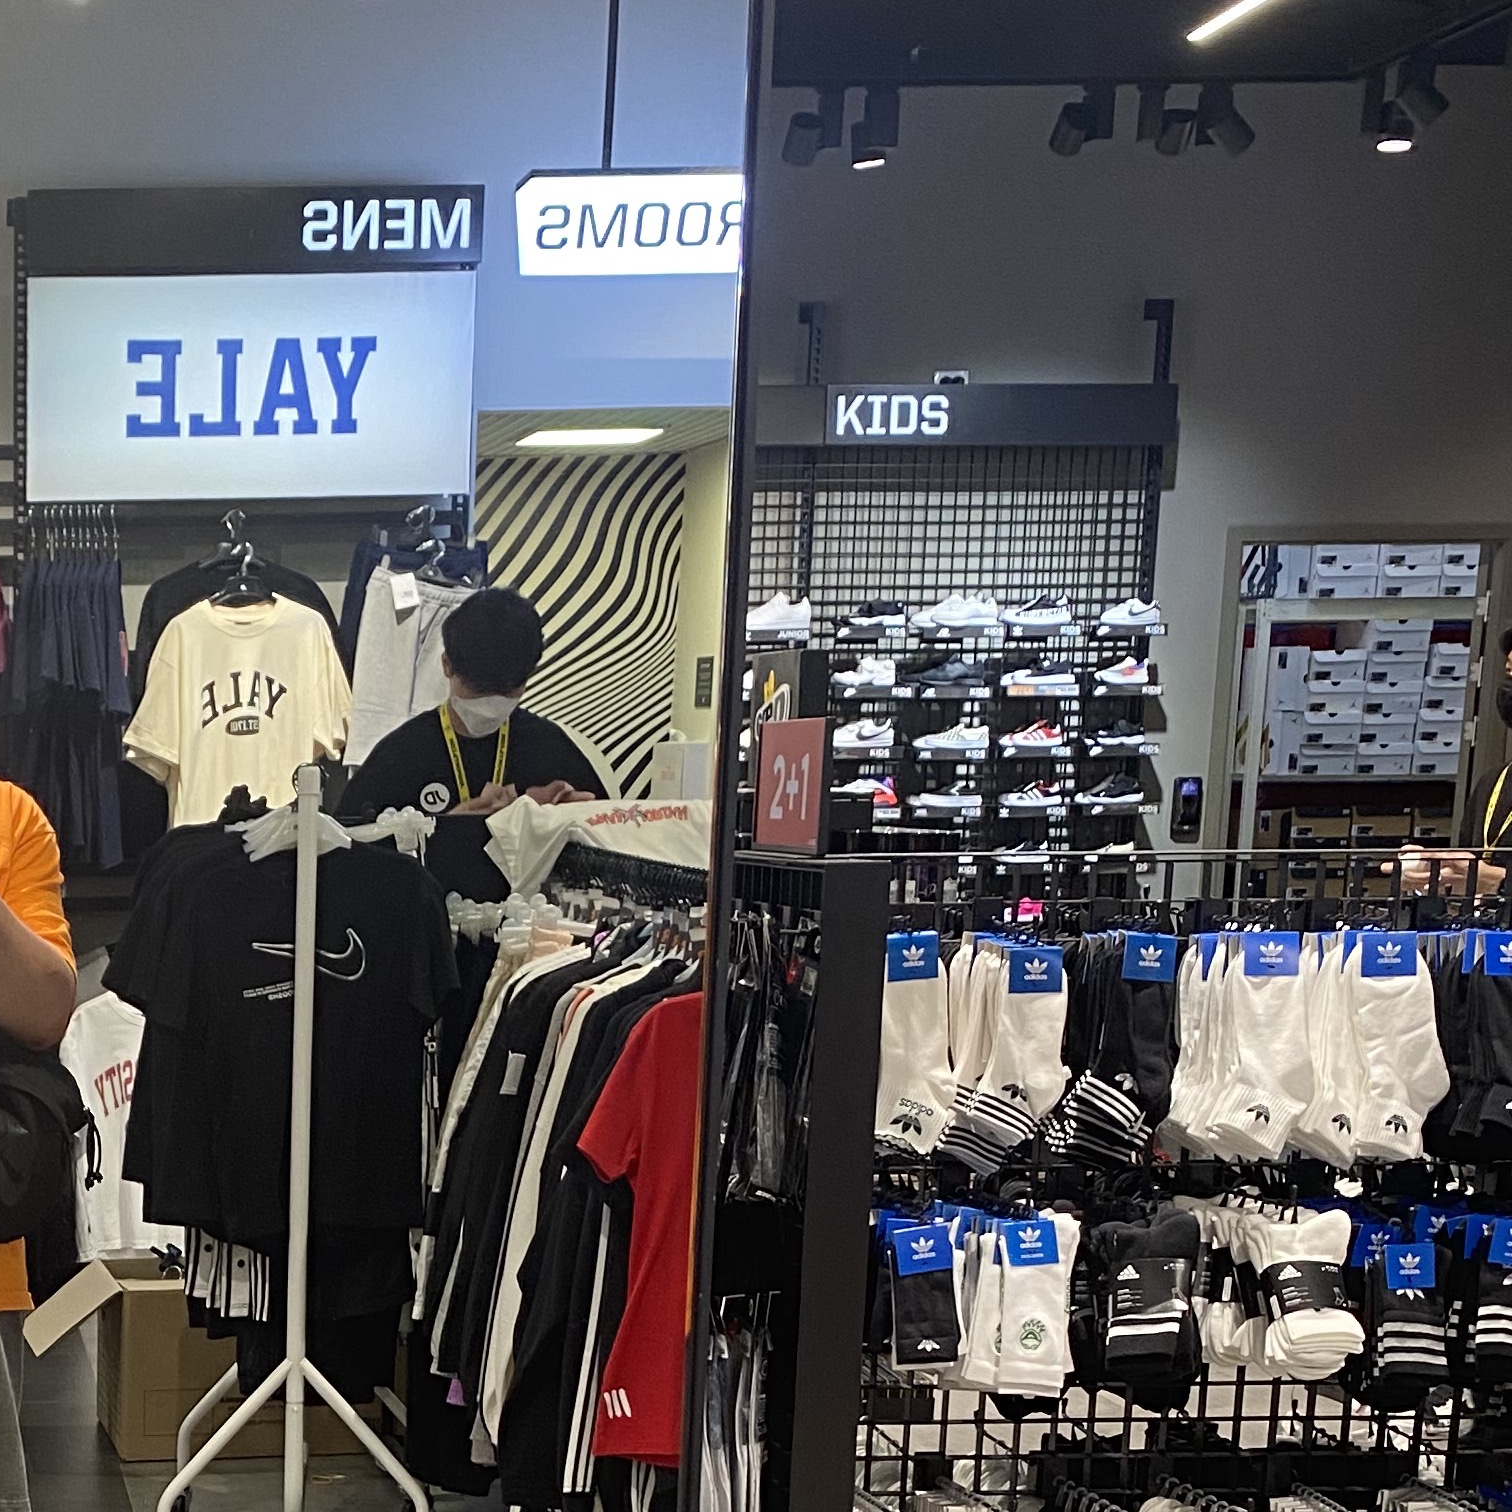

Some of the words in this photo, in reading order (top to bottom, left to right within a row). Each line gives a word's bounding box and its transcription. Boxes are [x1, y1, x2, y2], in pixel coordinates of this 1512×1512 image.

[836, 395, 949, 435] KIDS
[778, 629, 810, 639] JUNIOR
[886, 627, 905, 636] KIDS
[984, 627, 1004, 636] KIDS
[1060, 626, 1080, 635] KIDS
[1145, 625, 1165, 634] KIDS
[891, 687, 912, 697] KIDS
[969, 687, 990, 697] KIDS
[1142, 686, 1162, 694] KIDS
[870, 748, 890, 757] KIDS
[966, 749, 986, 759] KIDS
[1051, 746, 1071, 755] KIDS
[1139, 745, 1159, 754] KIDS
[769, 752, 809, 821] 2+1
[961, 807, 981, 816] KIDS
[1047, 806, 1066, 815] KIDS
[1139, 805, 1158, 813] KIDS
[899, 1097, 934, 1116] adidas
